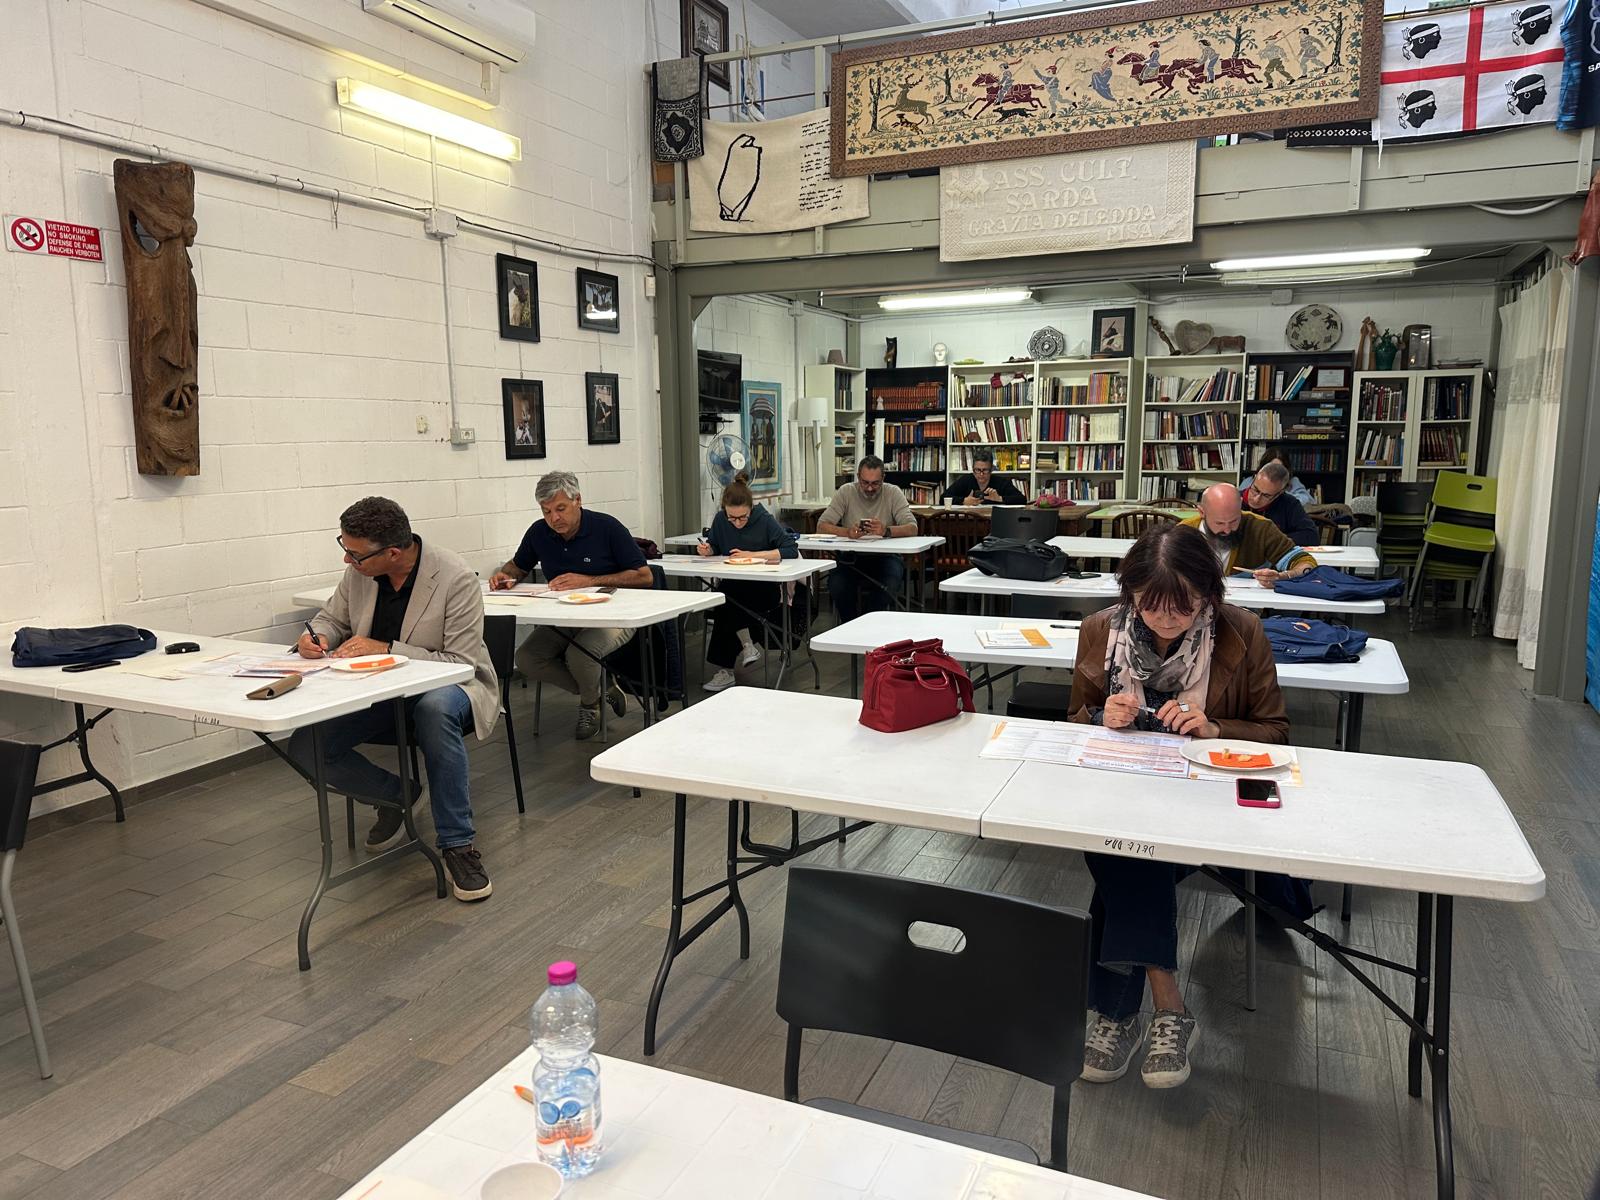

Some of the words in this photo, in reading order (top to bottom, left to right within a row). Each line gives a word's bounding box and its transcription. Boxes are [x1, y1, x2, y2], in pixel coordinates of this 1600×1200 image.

[992, 165, 1052, 192] ASS.
[1060, 156, 1137, 184] CULT.
[1005, 186, 1100, 214] SARDA
[968, 214, 1046, 237] GRAZIA
[1053, 204, 1156, 229] DELEDDA
[47, 223, 70, 232] VIETATO
[72, 227, 95, 236] FUMARE
[59, 232, 86, 242] SMOKING
[1105, 223, 1154, 241] PISA
[49, 238, 73, 247] DEFENSE
[50, 246, 73, 254] RAUCHEN
